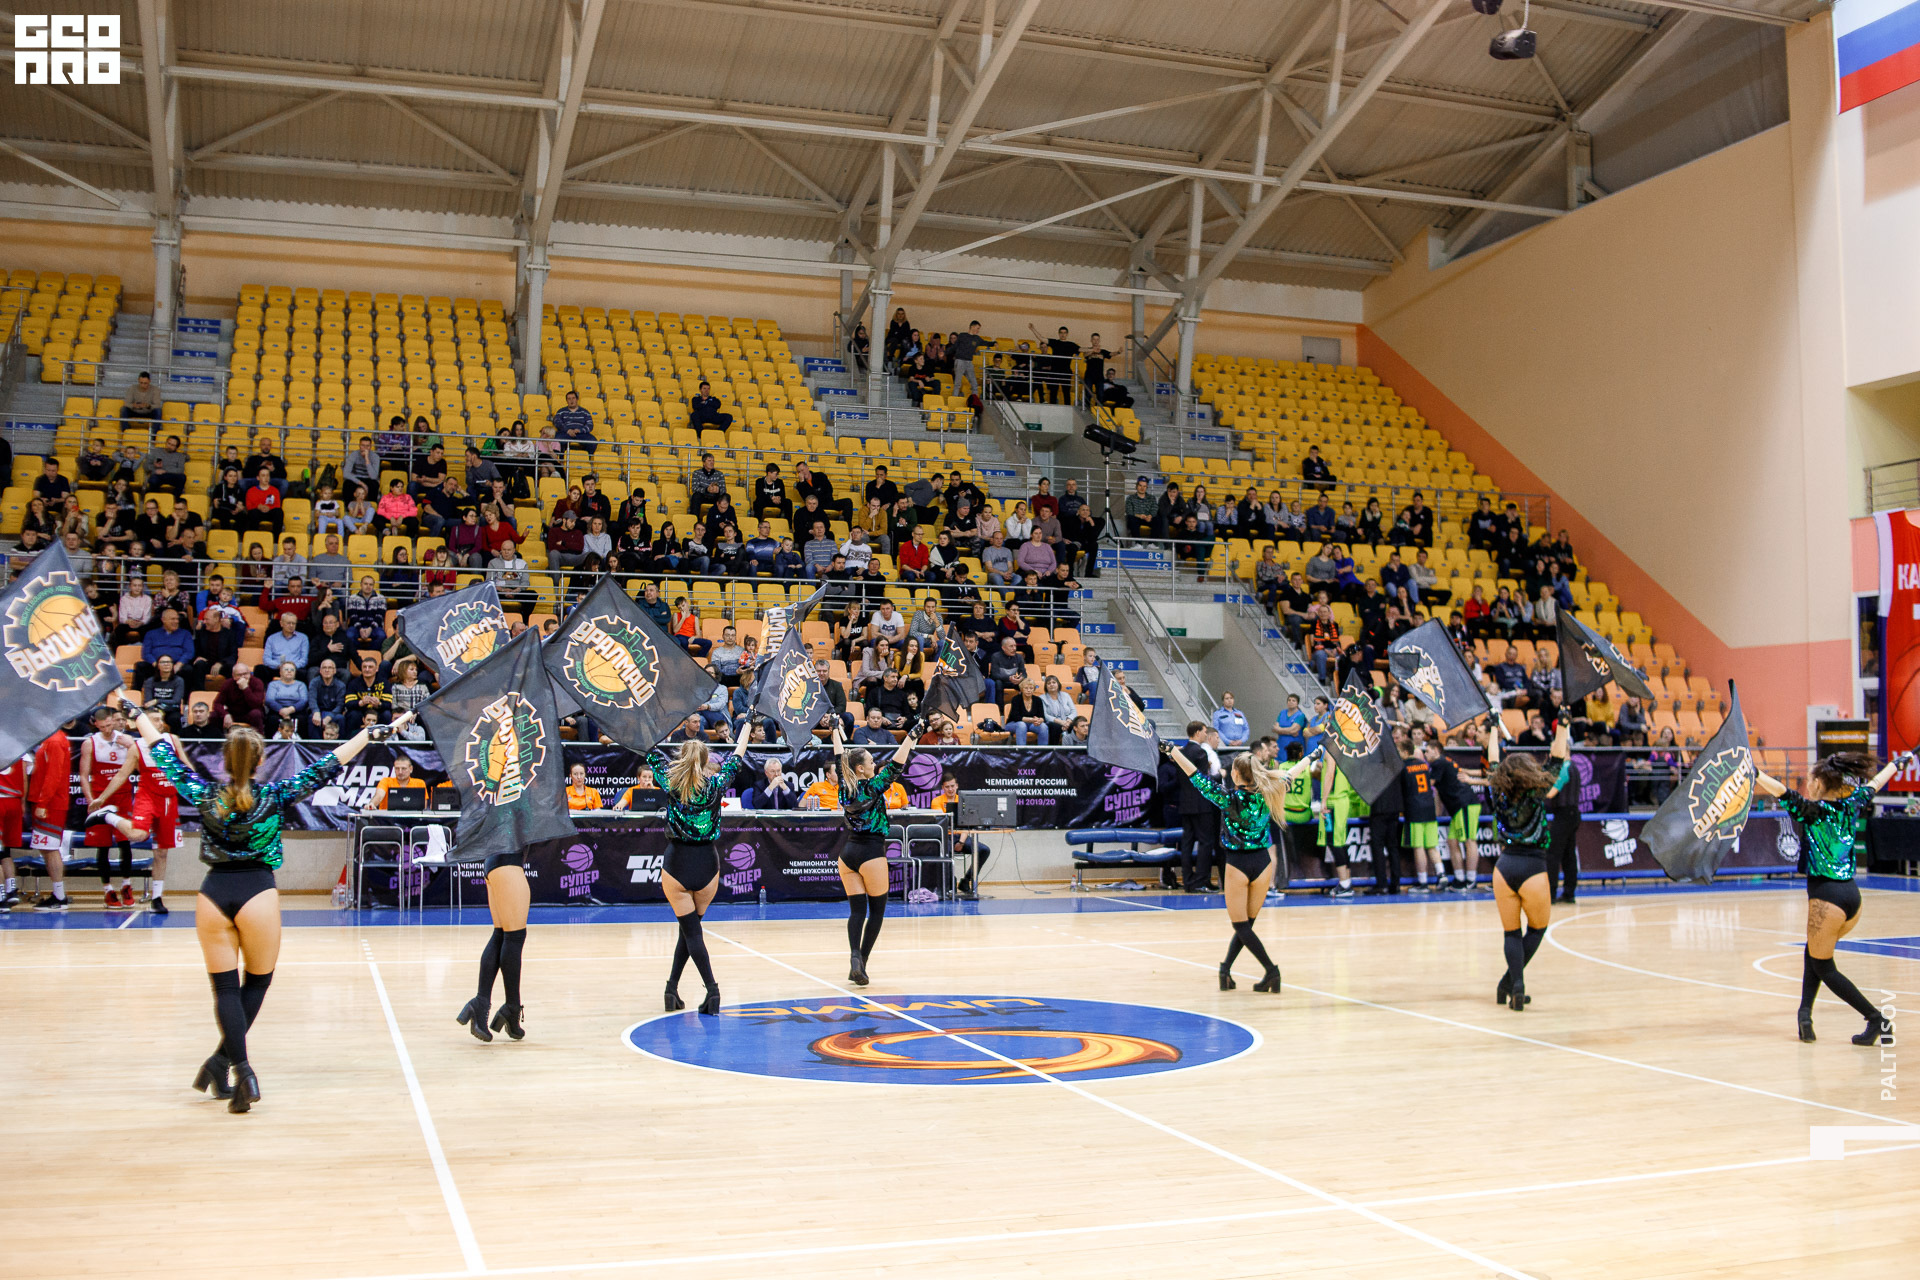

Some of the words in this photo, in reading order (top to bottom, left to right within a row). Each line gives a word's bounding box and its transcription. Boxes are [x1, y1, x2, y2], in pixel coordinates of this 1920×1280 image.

[569, 621, 656, 706] УРАЛМАШ
[1334, 698, 1380, 754] РАЛМАШ
[109, 752, 118, 762] 8
[1416, 773, 1428, 793] 9
[1104, 787, 1151, 812] СУПЕР
[1114, 807, 1142, 822] ЛИГА
[32, 834, 48, 846] 34
[1604, 838, 1637, 860] СУПЕР
[626, 855, 664, 869] ПА
[560, 870, 600, 889] СУПЕР
[724, 868, 762, 887] СУПЕР
[568, 884, 591, 898] ЛИГА
[732, 882, 753, 895] ЛИГА
